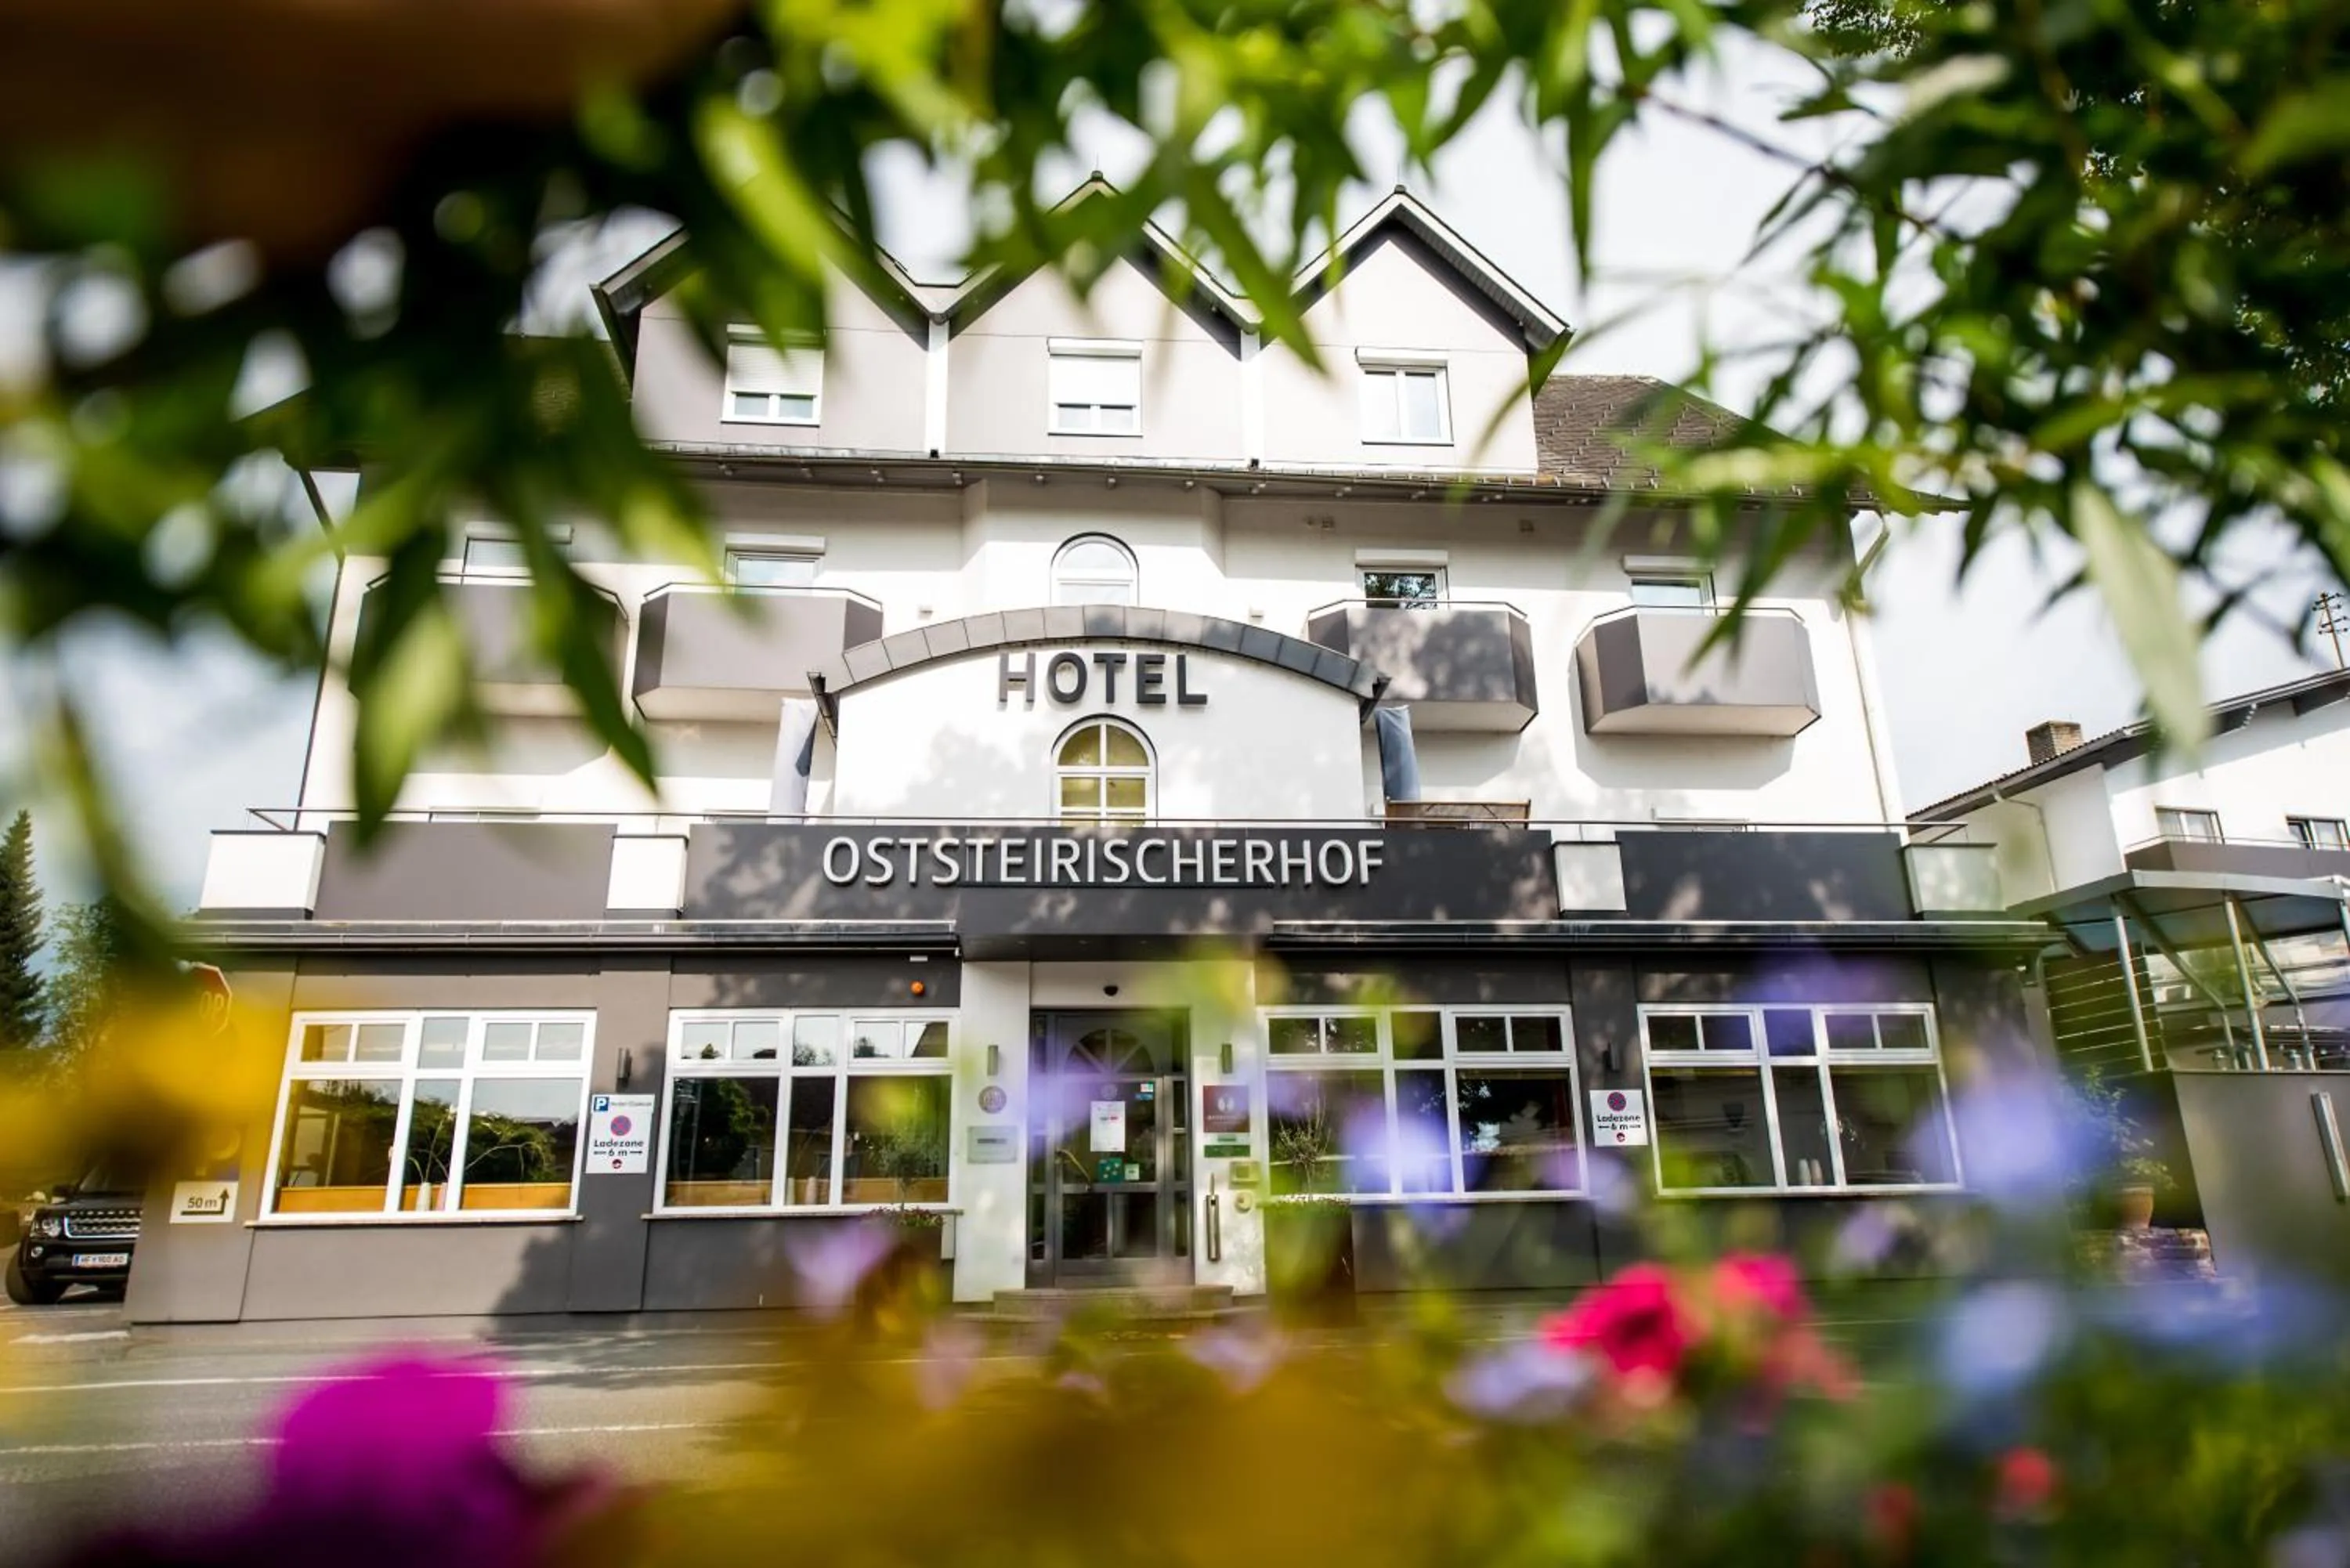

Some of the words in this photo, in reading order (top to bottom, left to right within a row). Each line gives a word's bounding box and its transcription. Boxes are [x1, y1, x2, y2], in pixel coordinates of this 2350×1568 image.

[999, 652, 1207, 705] HOTEL
[823, 836, 1384, 885] OSTSTEIRISCHERHOF
[595, 1097, 607, 1110] P
[1596, 1114, 1641, 1122] Ladezone
[593, 1138, 645, 1147] Ladezone
[608, 1148, 615, 1157] 6
[188, 1196, 203, 1209] 50
[204, 1198, 218, 1209] m
